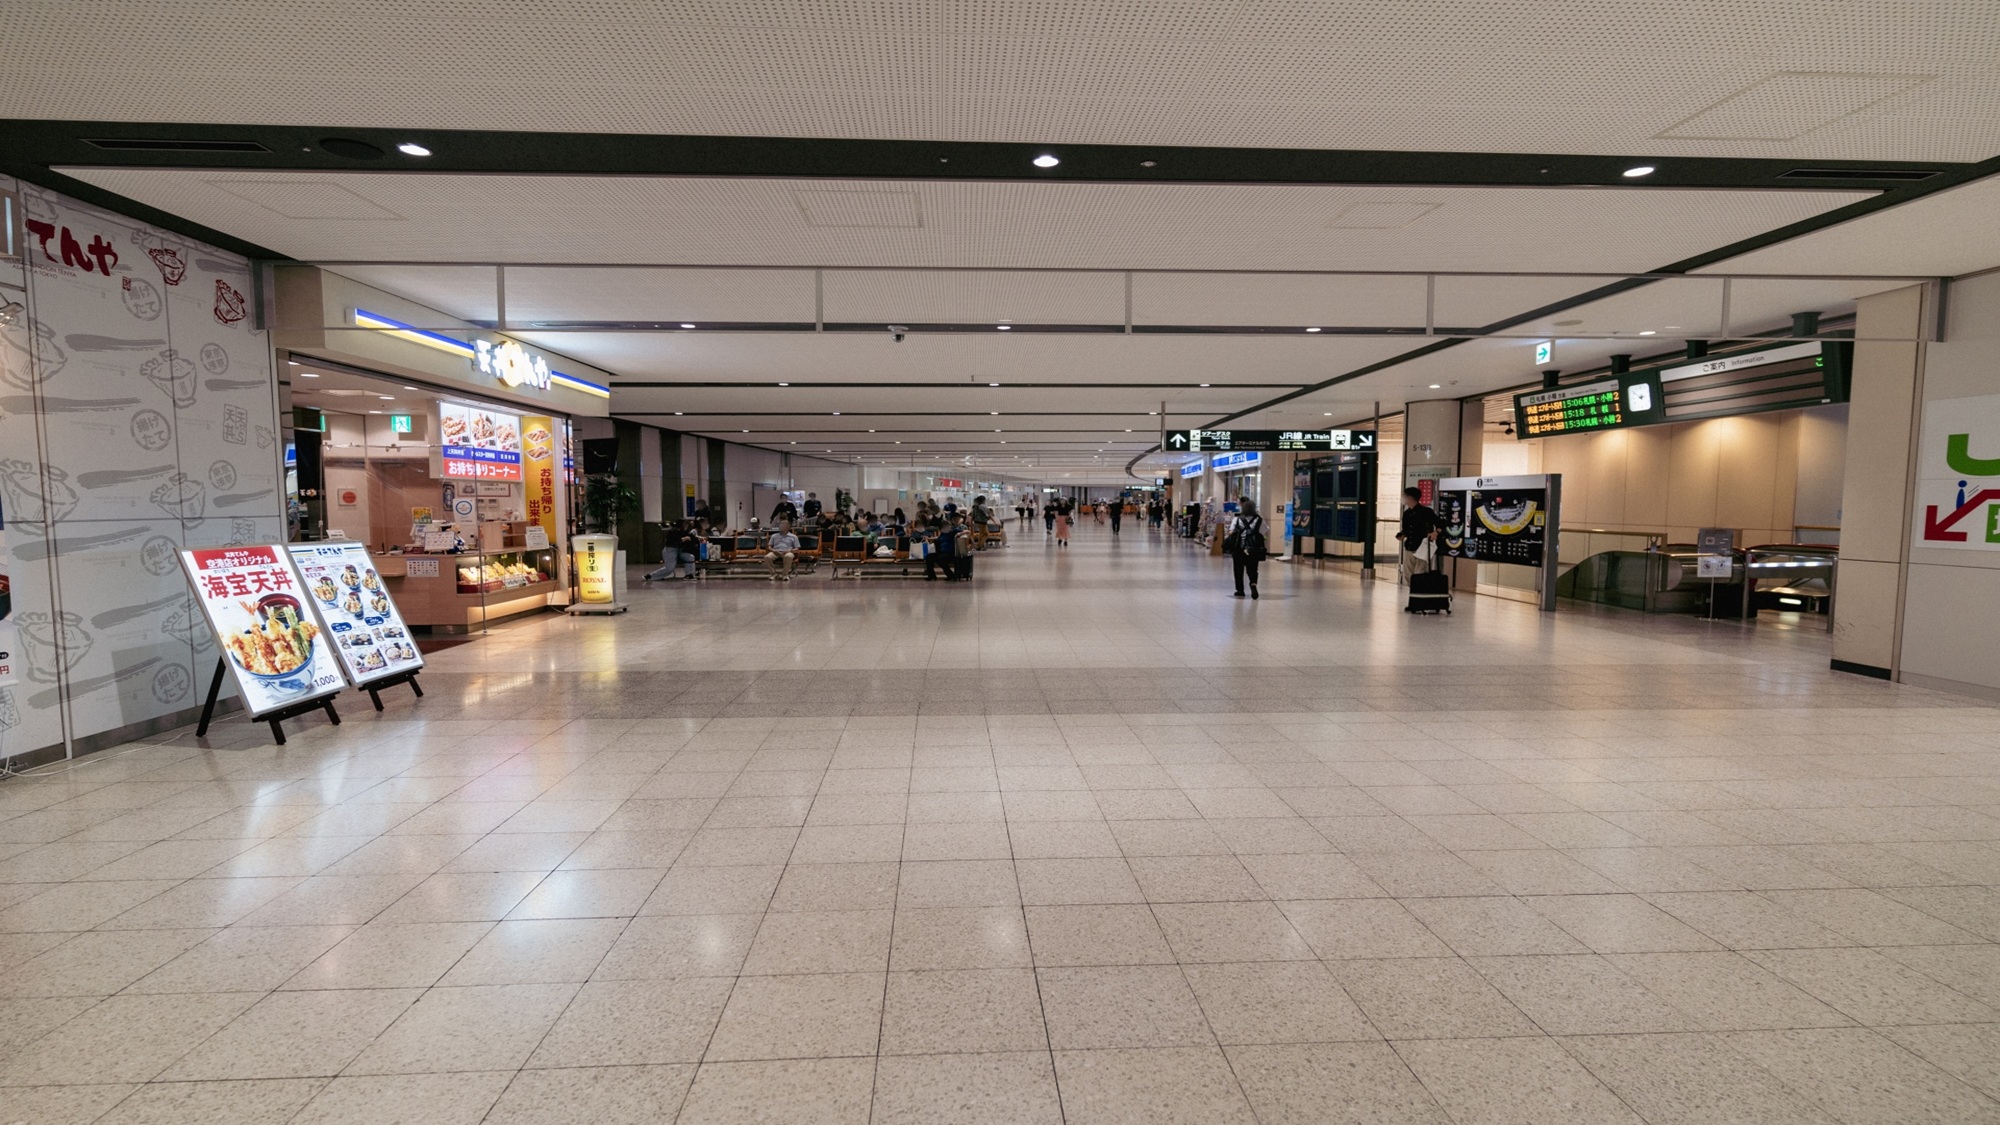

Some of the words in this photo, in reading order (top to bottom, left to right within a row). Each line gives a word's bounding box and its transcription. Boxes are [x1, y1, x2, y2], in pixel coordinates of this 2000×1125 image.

[25, 218, 119, 276] てんや
[1702, 361, 1726, 372] ご案内
[1731, 354, 1765, 366] Information
[1563, 398, 1583, 408] 15:06
[1613, 391, 1619, 400] 2
[1564, 408, 1585, 419] 15:18
[1615, 403, 1620, 411] 1
[1564, 419, 1586, 429] 15:30
[1616, 414, 1621, 423] 2
[1279, 432, 1302, 440] JR線
[448, 460, 517, 477] お持ち帰りコーナー
[540, 468, 553, 514] お持ち帰り
[206, 555, 271, 569] 空港店オリジナル
[200, 567, 293, 599] 海宝天丼
